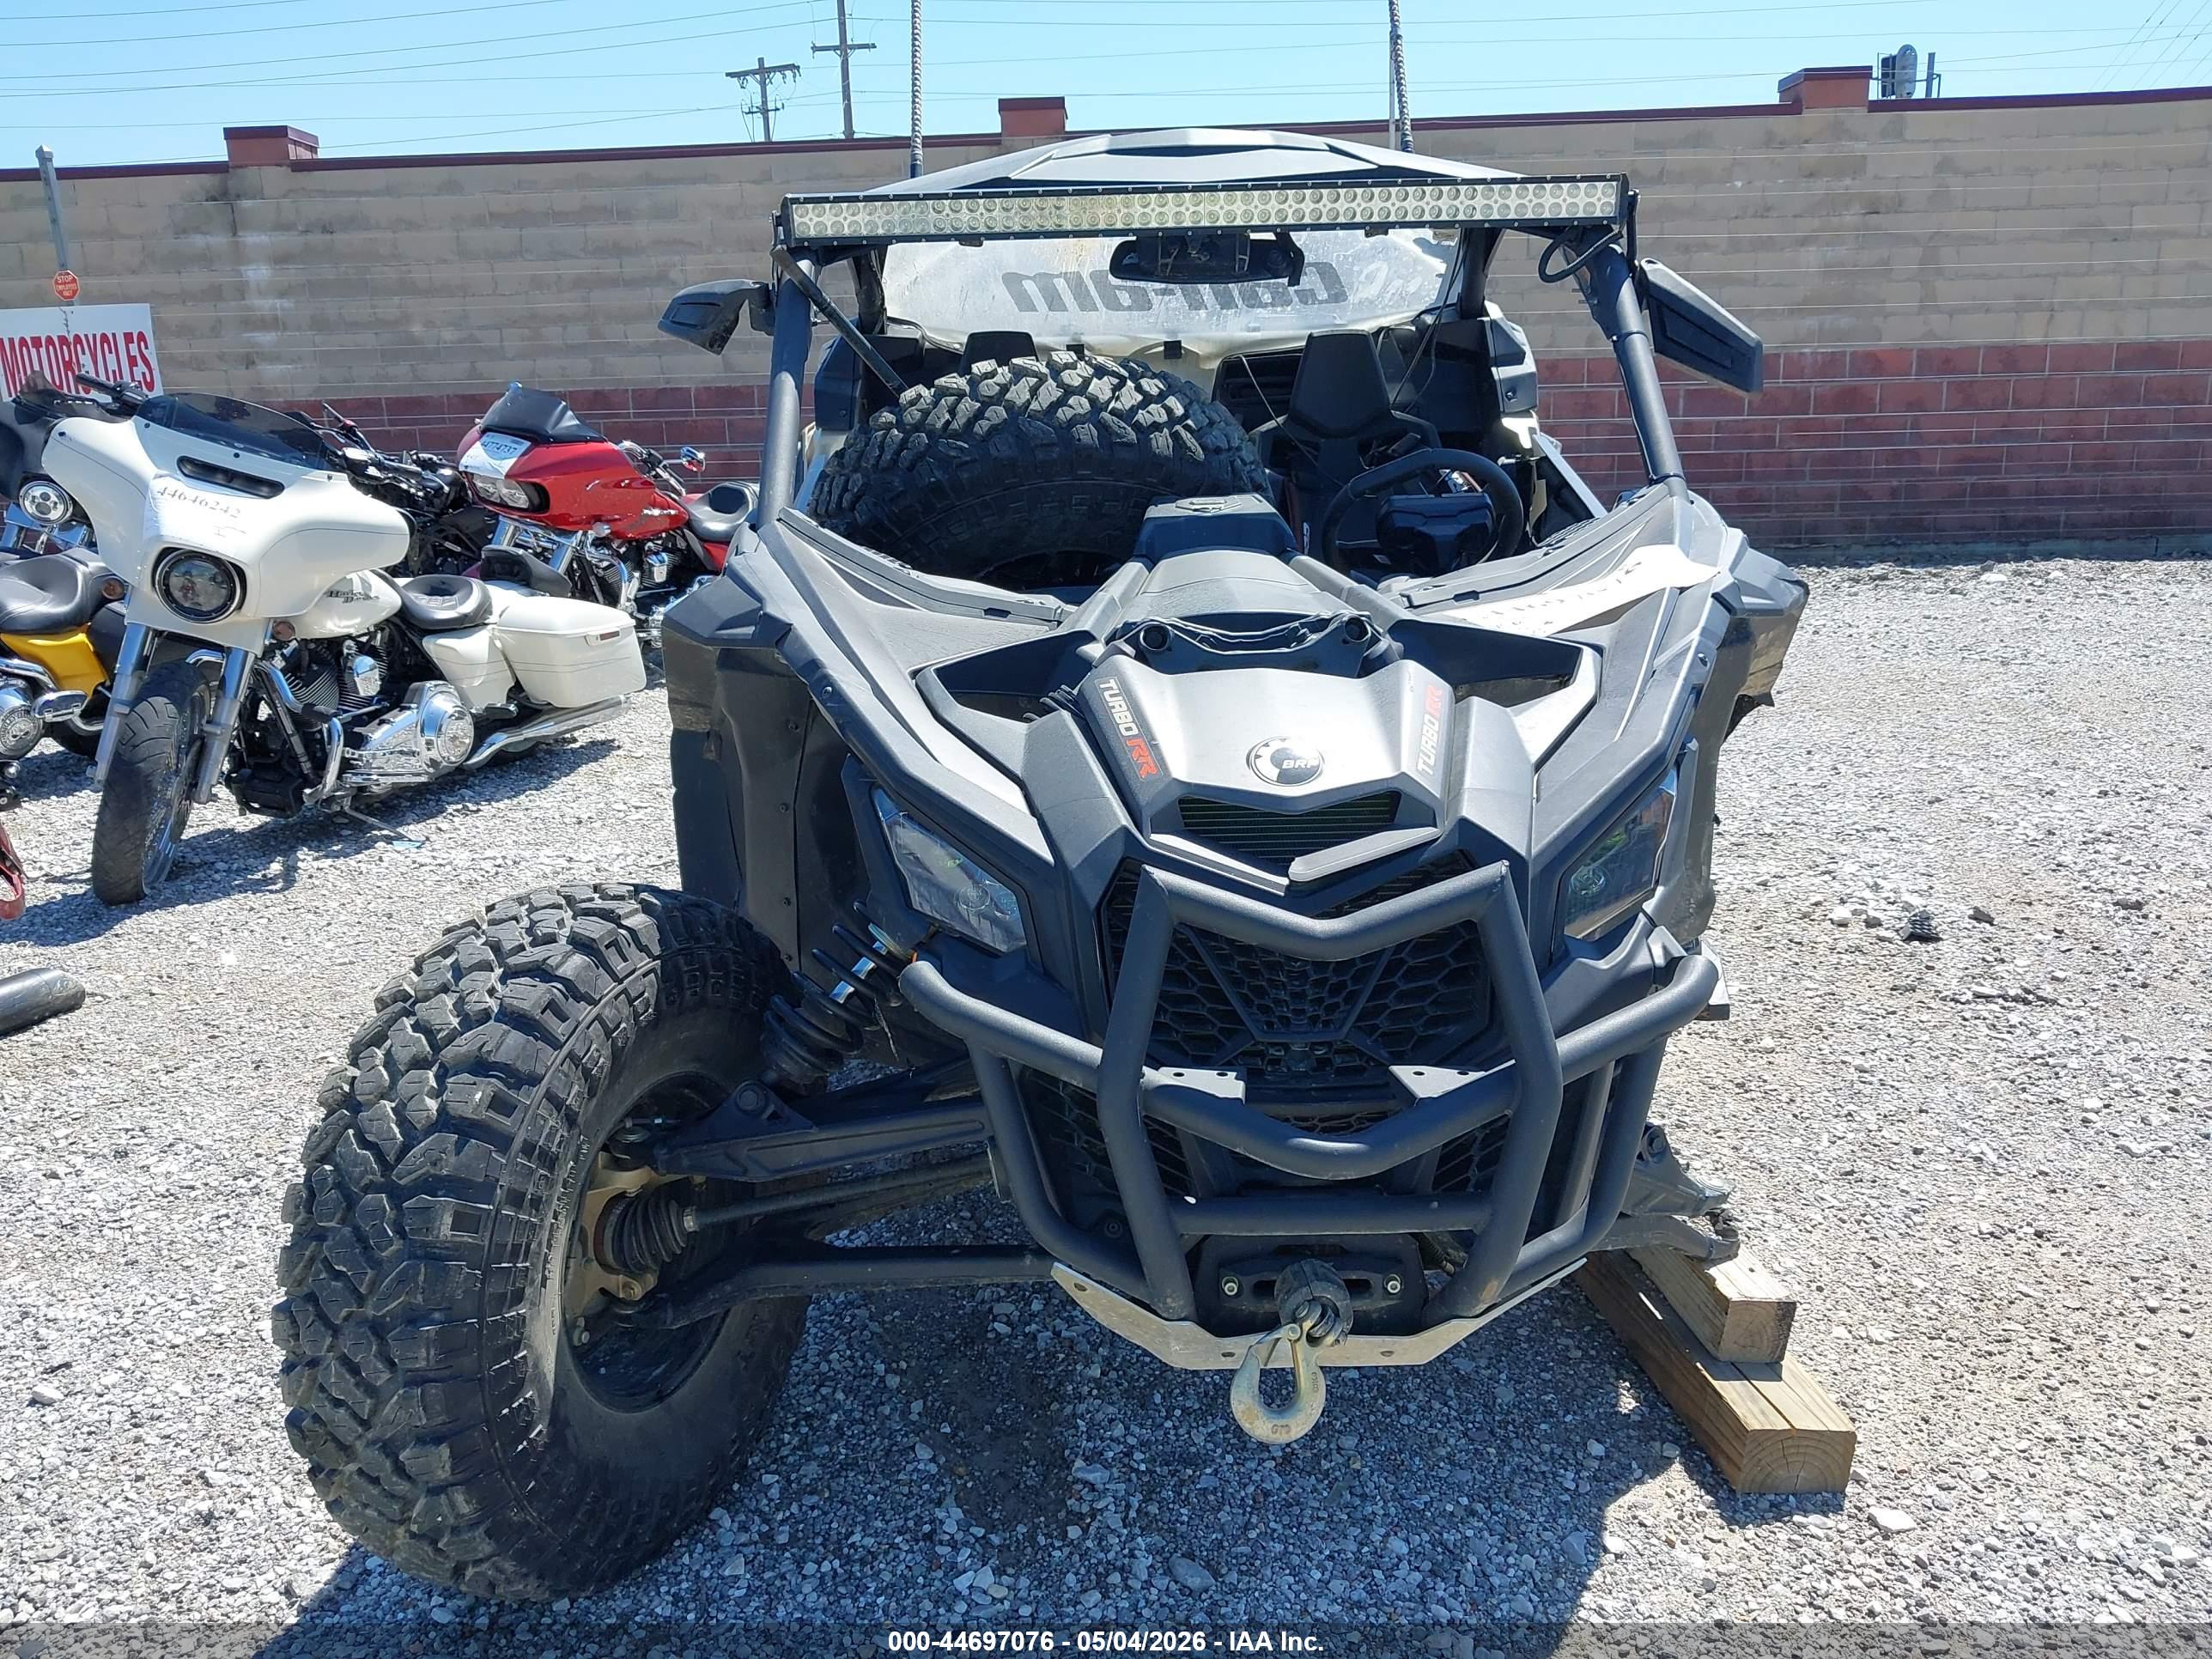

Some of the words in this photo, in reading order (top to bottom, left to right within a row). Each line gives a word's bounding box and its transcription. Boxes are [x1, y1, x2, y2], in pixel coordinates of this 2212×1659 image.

[57, 275, 73, 283] STOP
[0, 331, 155, 398] MOTORCYCLES
[1099, 678, 1139, 736] TURBO
[1126, 738, 1158, 779] RR
[1417, 713, 1439, 775] TURBO
